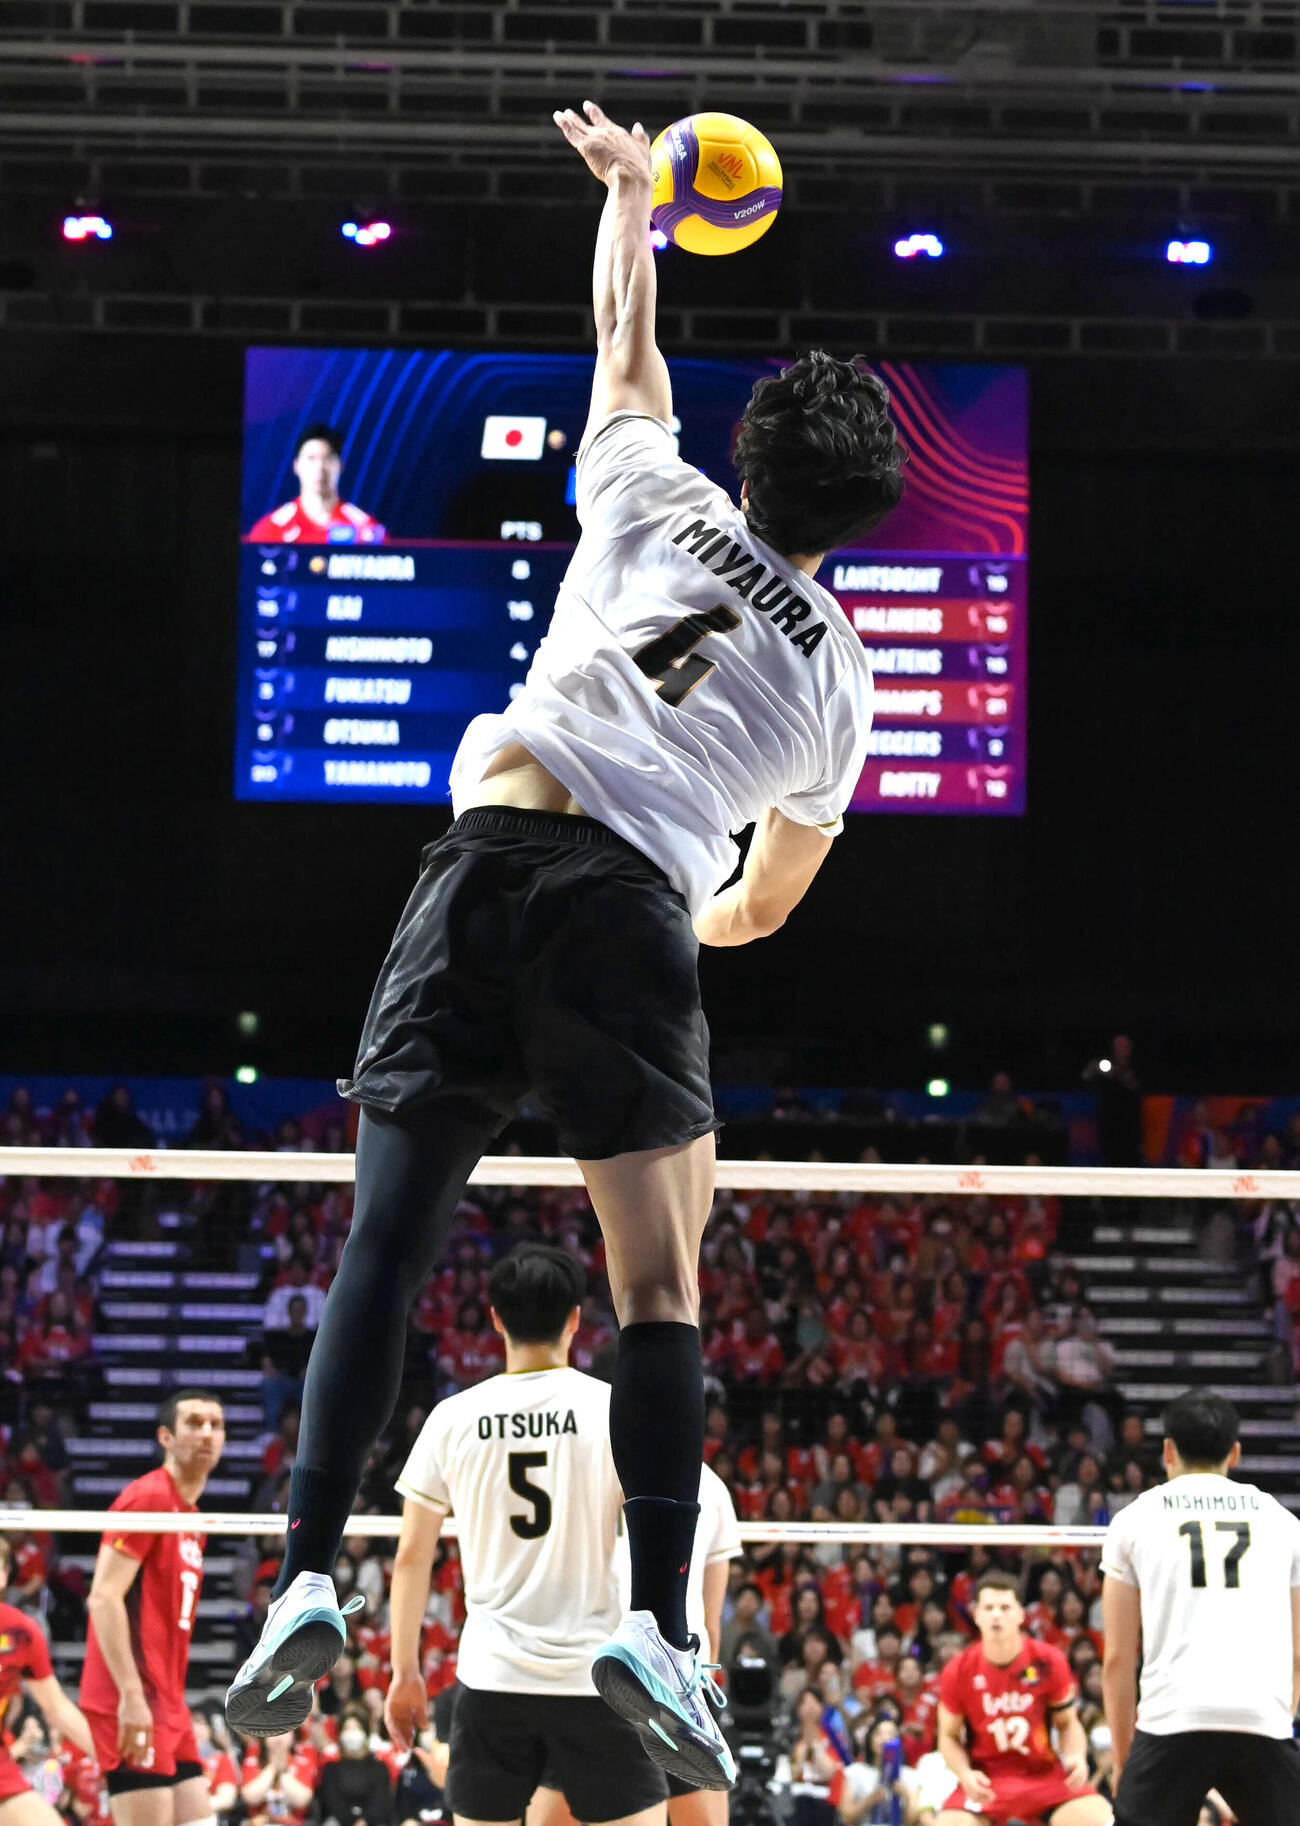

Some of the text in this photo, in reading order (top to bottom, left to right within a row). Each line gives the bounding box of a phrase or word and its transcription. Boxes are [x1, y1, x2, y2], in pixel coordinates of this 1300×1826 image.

[718, 153, 743, 179] VNL
[733, 198, 766, 220] V200W
[500, 521, 543, 541] PTS
[672, 519, 828, 659] MIYAURA
[478, 1409, 578, 1440] OTSUKA
[508, 1451, 552, 1540] 5
[1178, 1520, 1251, 1588] 17
[987, 1716, 1031, 1756] 12
